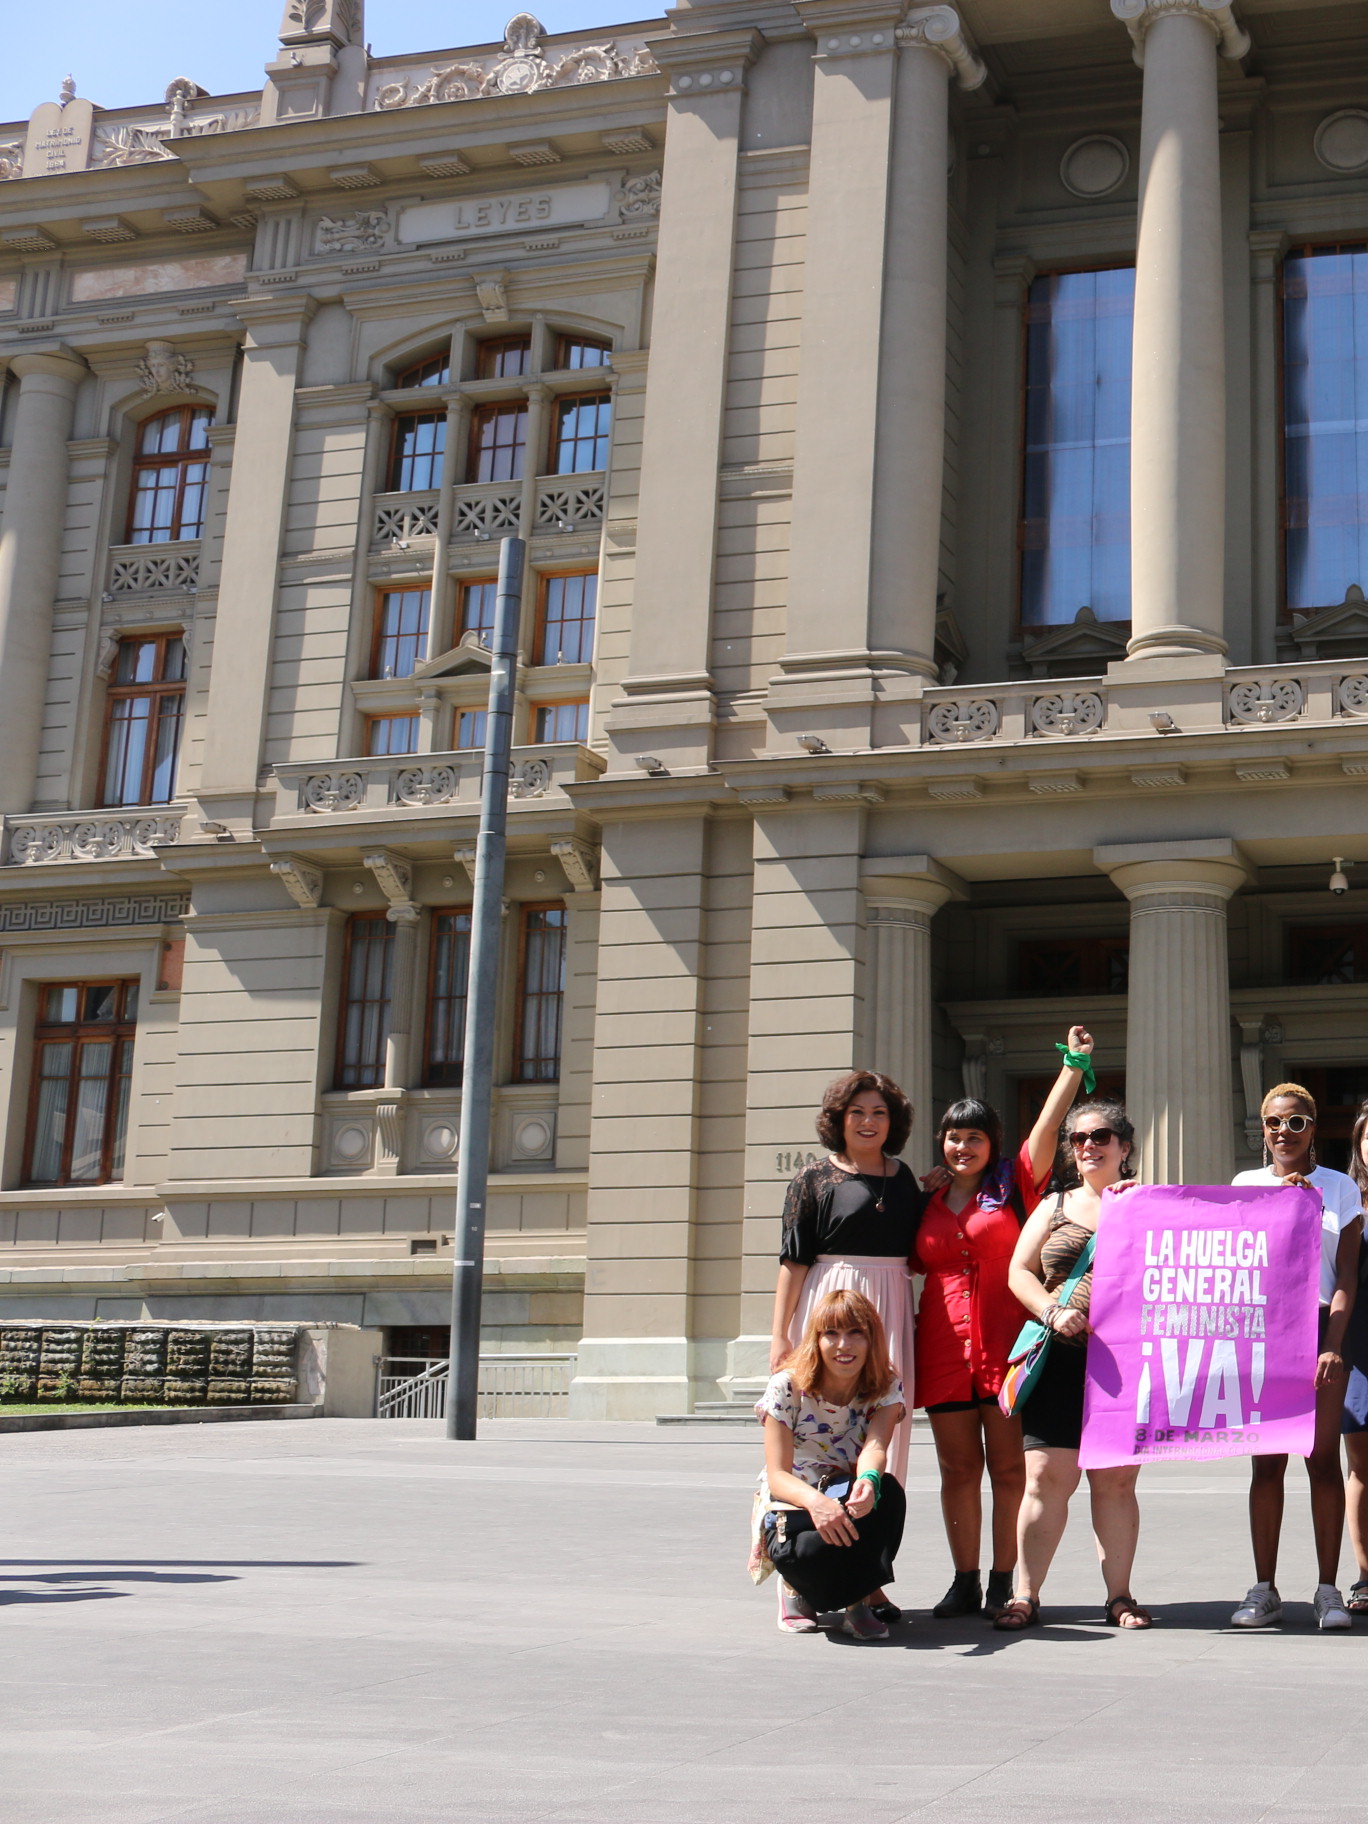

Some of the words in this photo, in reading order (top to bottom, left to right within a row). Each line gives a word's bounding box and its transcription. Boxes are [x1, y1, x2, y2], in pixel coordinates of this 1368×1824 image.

[35, 136, 82, 150] MATRIMONIO
[47, 128, 62, 138] LEY
[63, 126, 74, 136] DE
[47, 150, 66, 160] CIVIL
[454, 193, 552, 230] LEYES
[1145, 1230, 1174, 1266] LA
[1180, 1230, 1268, 1268] HUELGA
[1143, 1268, 1267, 1305] GENERAL
[1141, 1304, 1265, 1338] FEMINISTA
[1136, 1338, 1265, 1429] ¡VA!
[1135, 1429, 1147, 1442] 8
[1155, 1430, 1175, 1442] DE
[1184, 1431, 1260, 1443] MARZO
